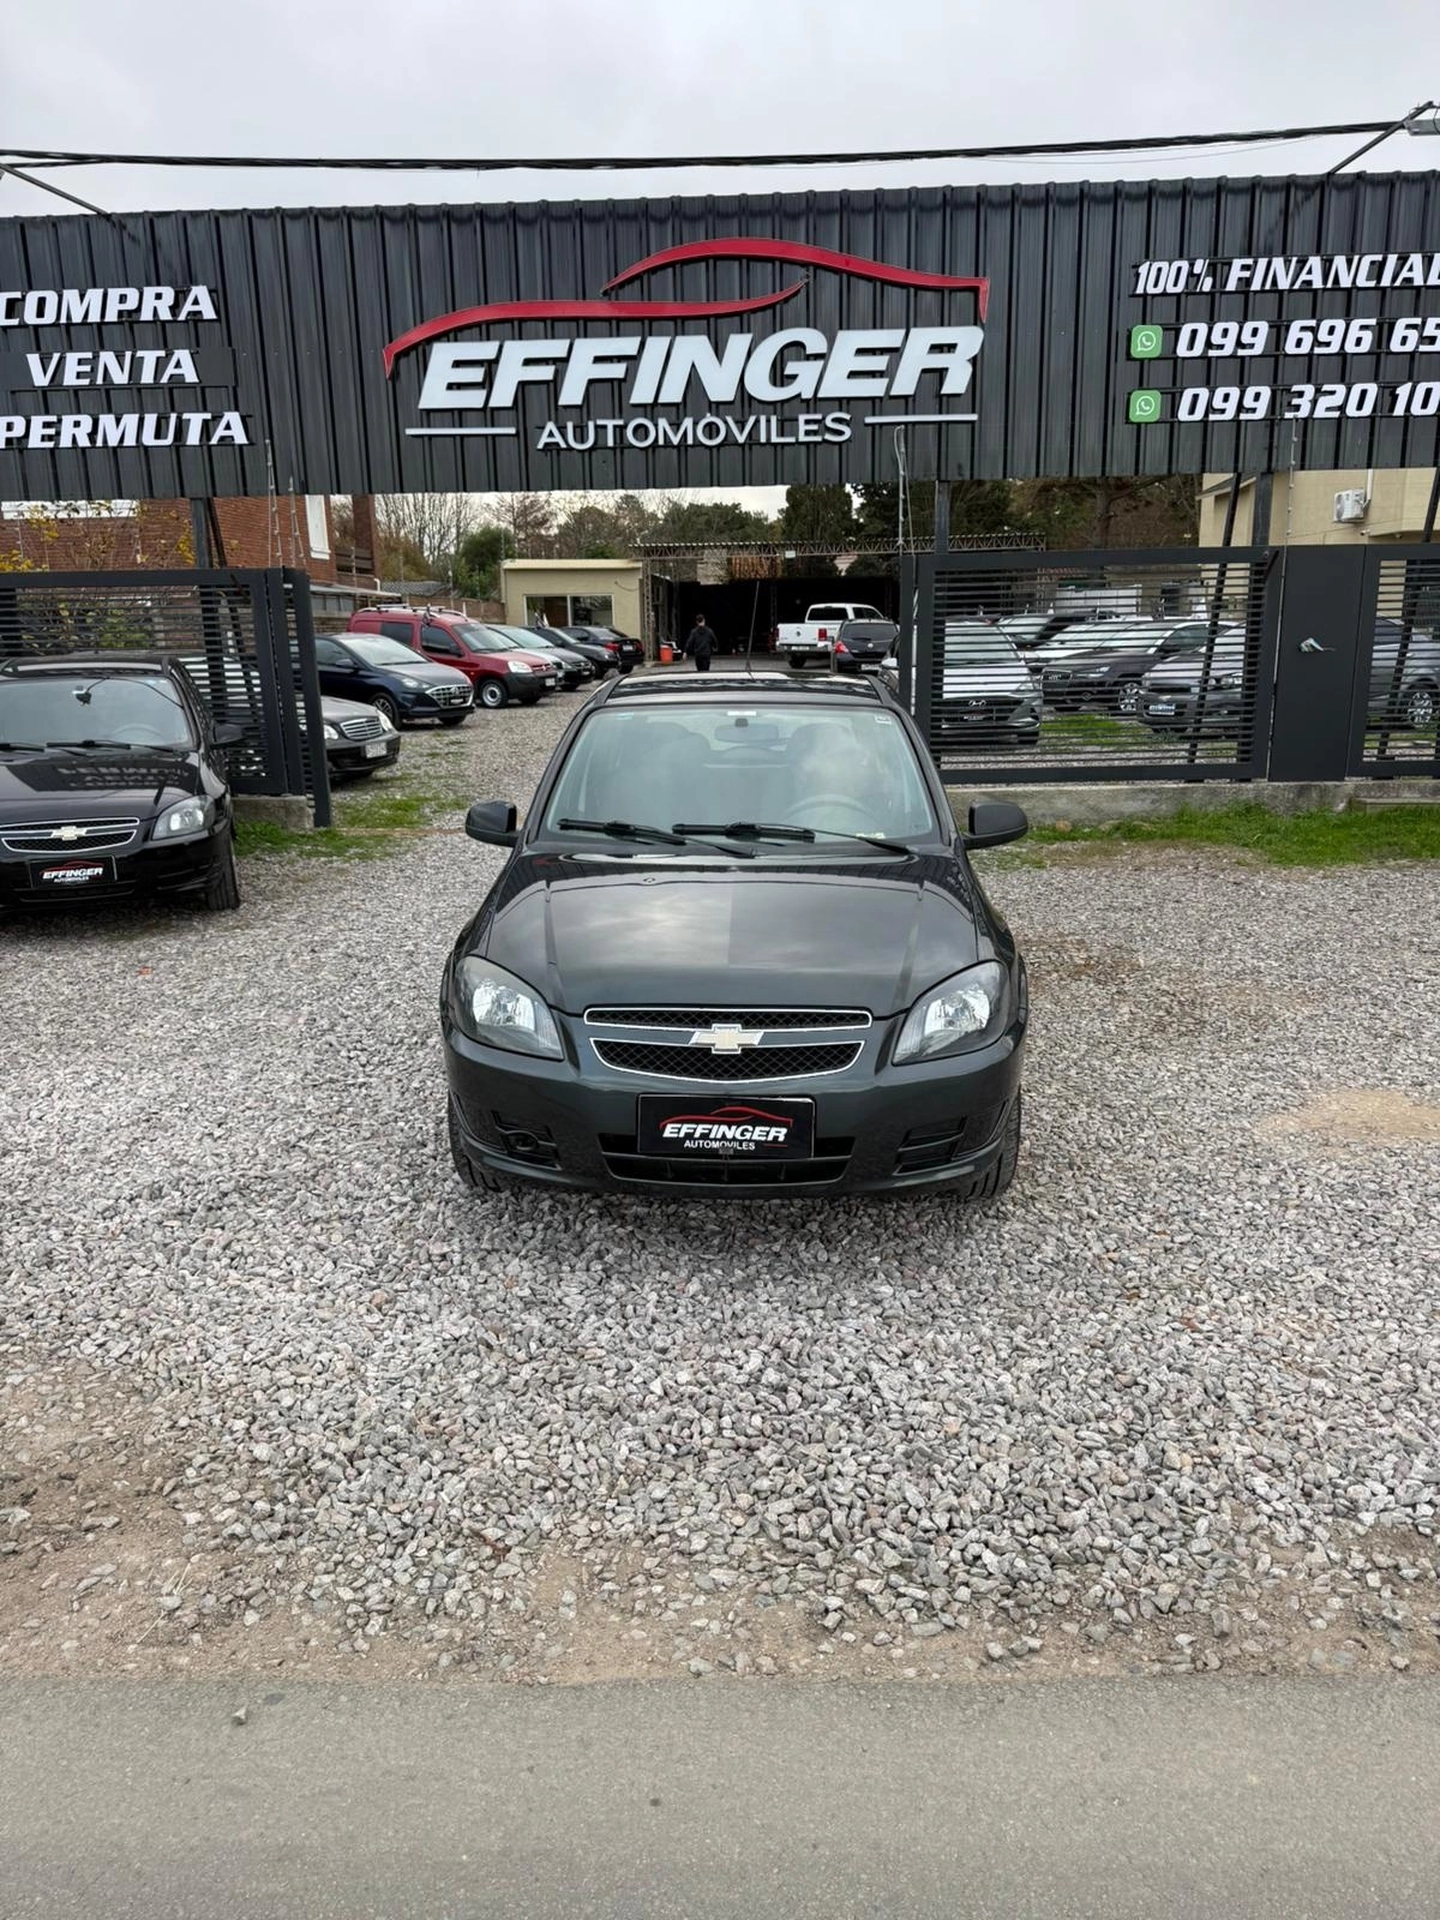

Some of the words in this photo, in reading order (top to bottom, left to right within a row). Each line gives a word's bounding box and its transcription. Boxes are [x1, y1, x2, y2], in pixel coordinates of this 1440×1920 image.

[1135, 258, 1213, 294] 100%
[1176, 321, 1269, 357] 099
[1284, 318, 1377, 354] 696
[26, 349, 199, 387] VENTA
[418, 325, 985, 409] EFFINGER
[1177, 386, 1272, 422] 099
[1284, 383, 1378, 418] 320
[1392, 381, 1440, 416] 10
[0, 411, 249, 449] PERMUTA
[42, 867, 103, 879] EFFINGER
[662, 1123, 788, 1142] EFFINGER
[683, 1139, 756, 1151] AUTOMOVILES
